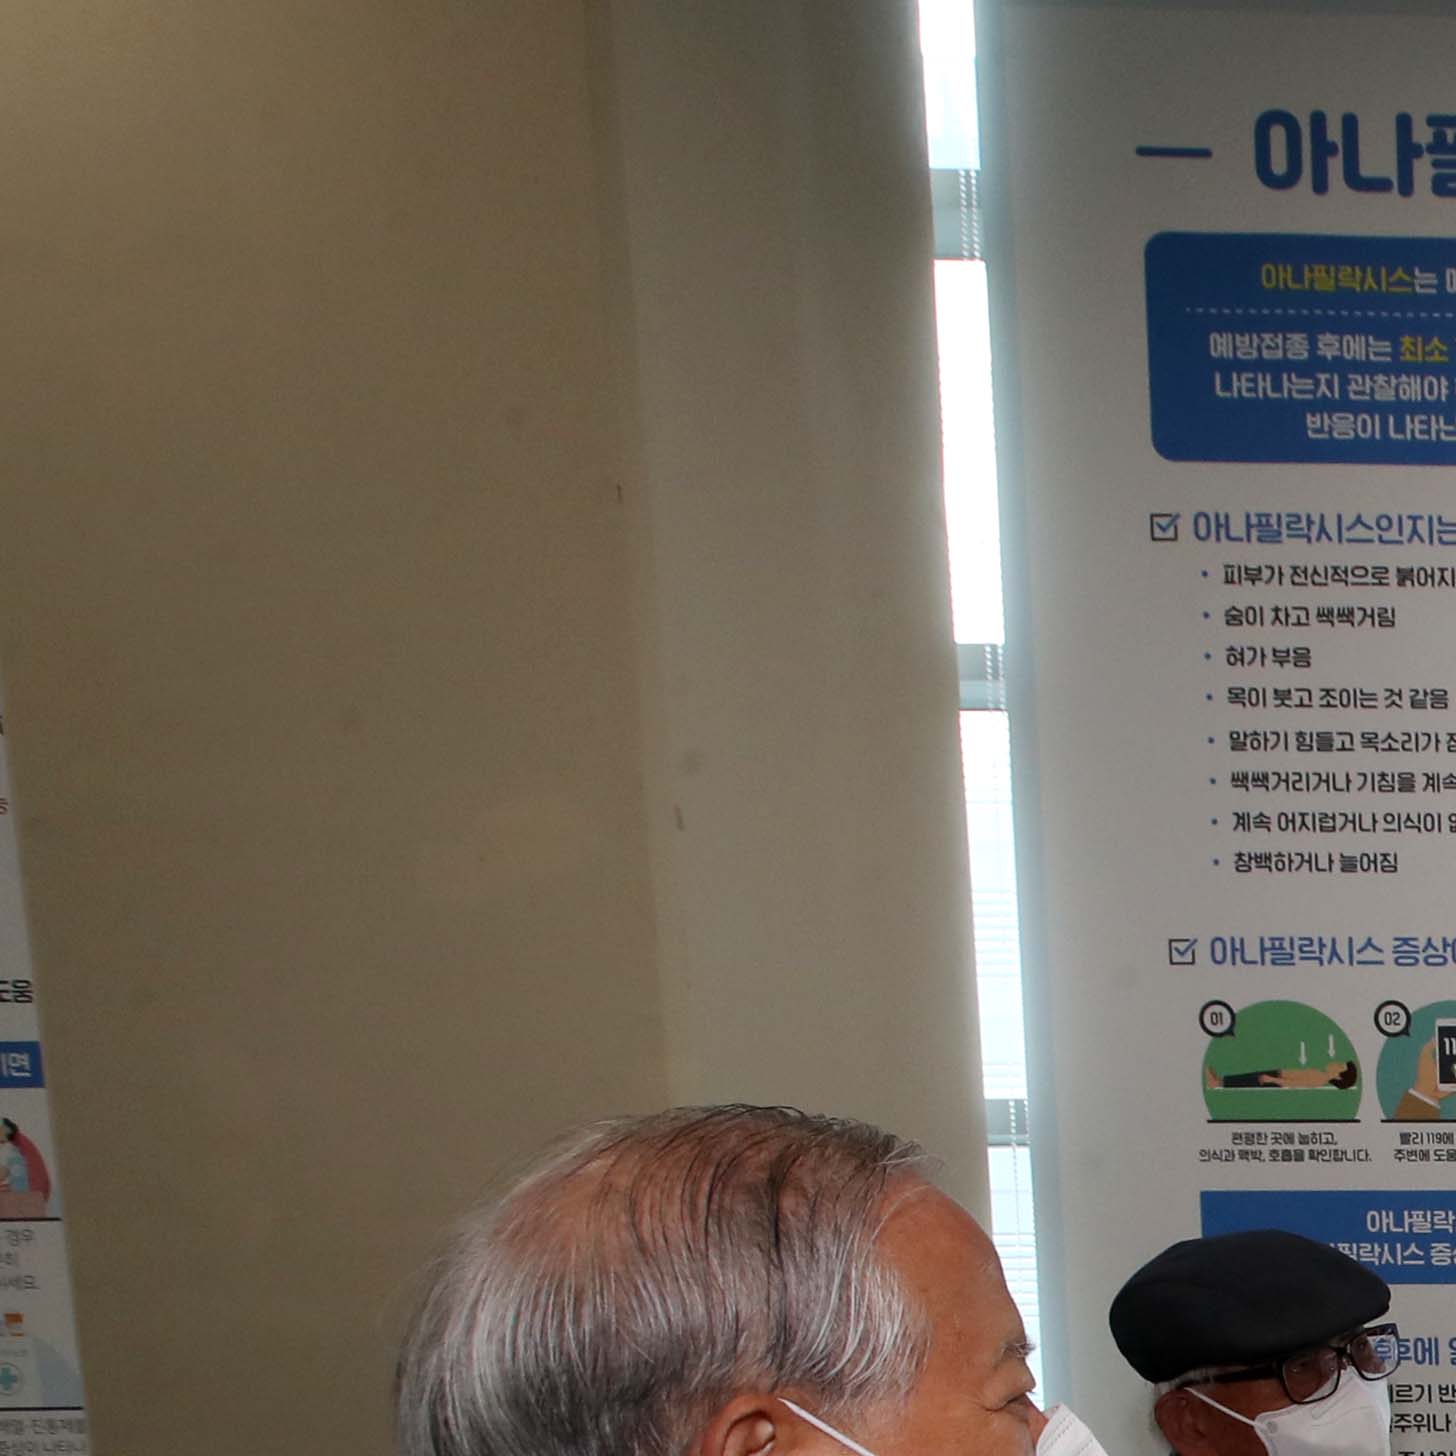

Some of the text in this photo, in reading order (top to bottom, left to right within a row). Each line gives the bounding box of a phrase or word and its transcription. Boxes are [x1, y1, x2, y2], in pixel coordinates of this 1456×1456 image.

[1260, 263, 1438, 294] 아나필락시스는
[1208, 332, 1310, 359] 예방접종
[1316, 332, 1392, 362] 후에는
[1399, 335, 1448, 361] 최소
[1222, 563, 1285, 586] 피부가
[1288, 564, 1390, 587] 전신적으로
[1223, 605, 1264, 627] 숨이
[1269, 605, 1310, 627] 차고
[1224, 645, 1312, 668] 혀가 부음
[1226, 686, 1449, 710] 목이 붓고 조이는 것 같음
[1228, 730, 1289, 752] 말하기
[1294, 730, 1355, 752] 힘들고
[1359, 731, 1441, 752] 목소리가
[1356, 771, 1416, 793] 기침을
[1231, 811, 1272, 832] 계속
[1276, 811, 1379, 833] 어지럽거나
[1382, 811, 1442, 833] 의식이
[1233, 851, 1398, 873] 창백하거나 늘어짐
[1209, 936, 1385, 966] 아나필락시스
[1210, 1011, 1225, 1027] 01
[1384, 1011, 1401, 1027] 02
[1329, 1243, 1424, 1265] 필락시스
[1388, 1384, 1432, 1404] 르기
